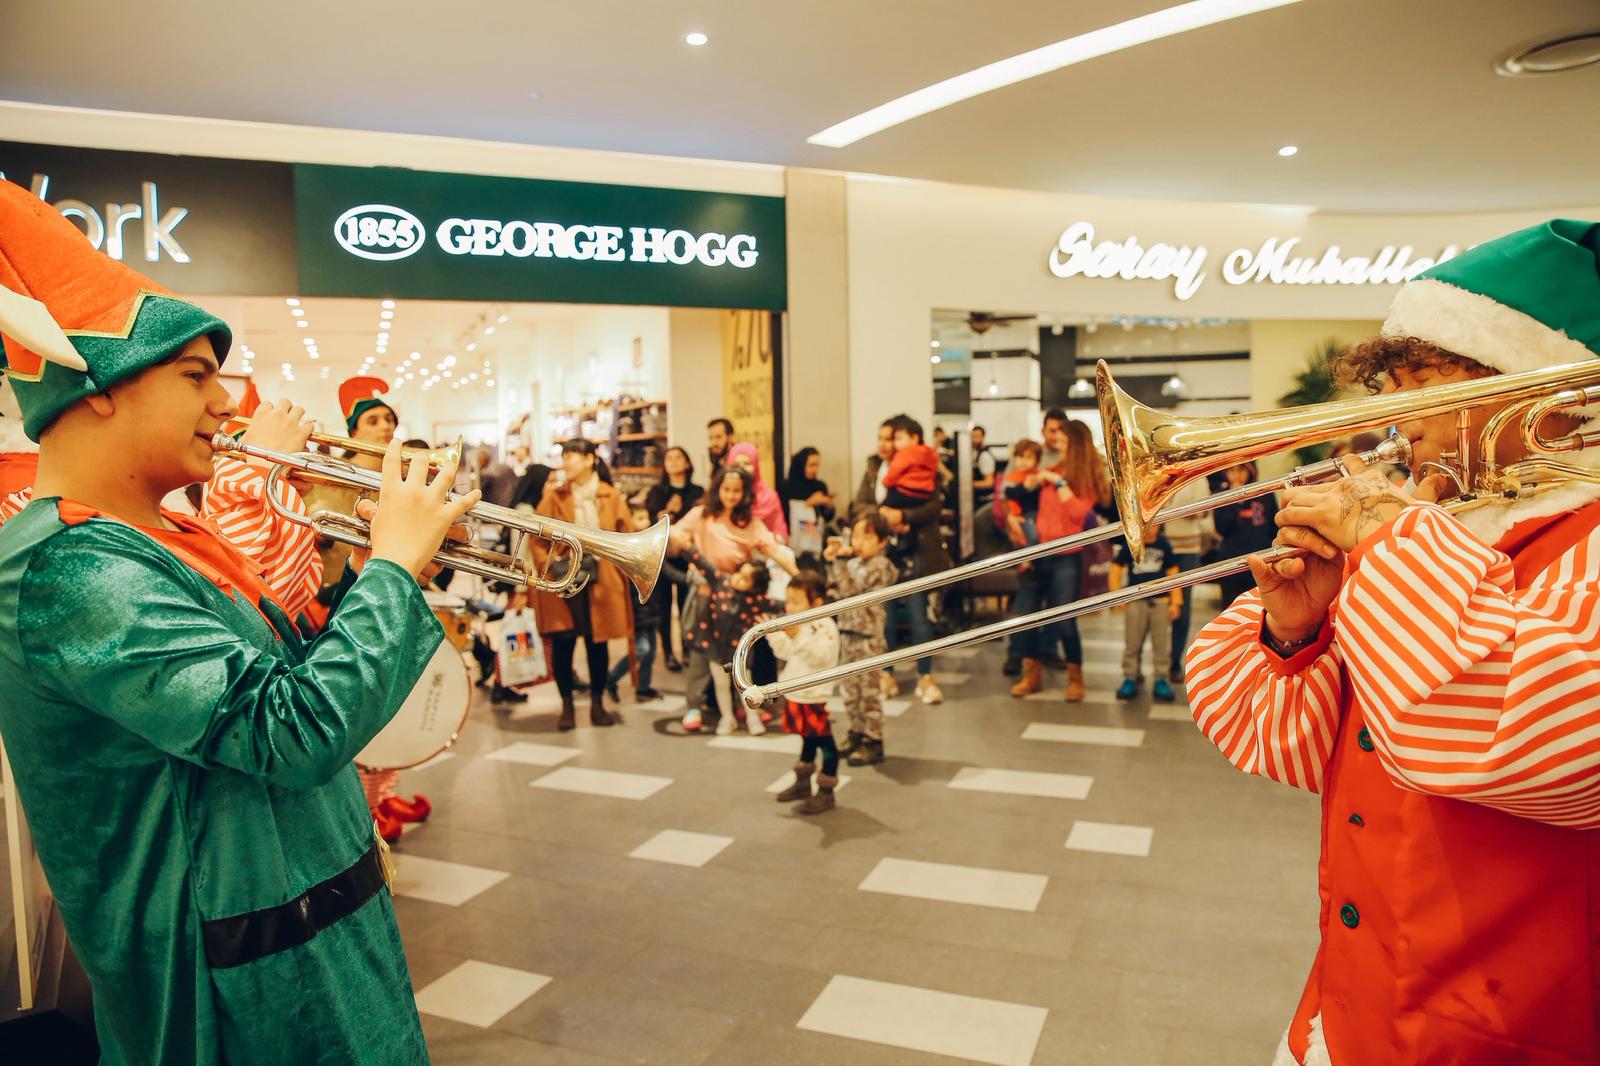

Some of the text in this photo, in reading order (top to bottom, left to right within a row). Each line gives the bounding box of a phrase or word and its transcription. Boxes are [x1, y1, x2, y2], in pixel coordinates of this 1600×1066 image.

[0, 171, 191, 263] ork
[346, 215, 416, 249] 1855
[435, 217, 760, 269] GEORGE HOGG
